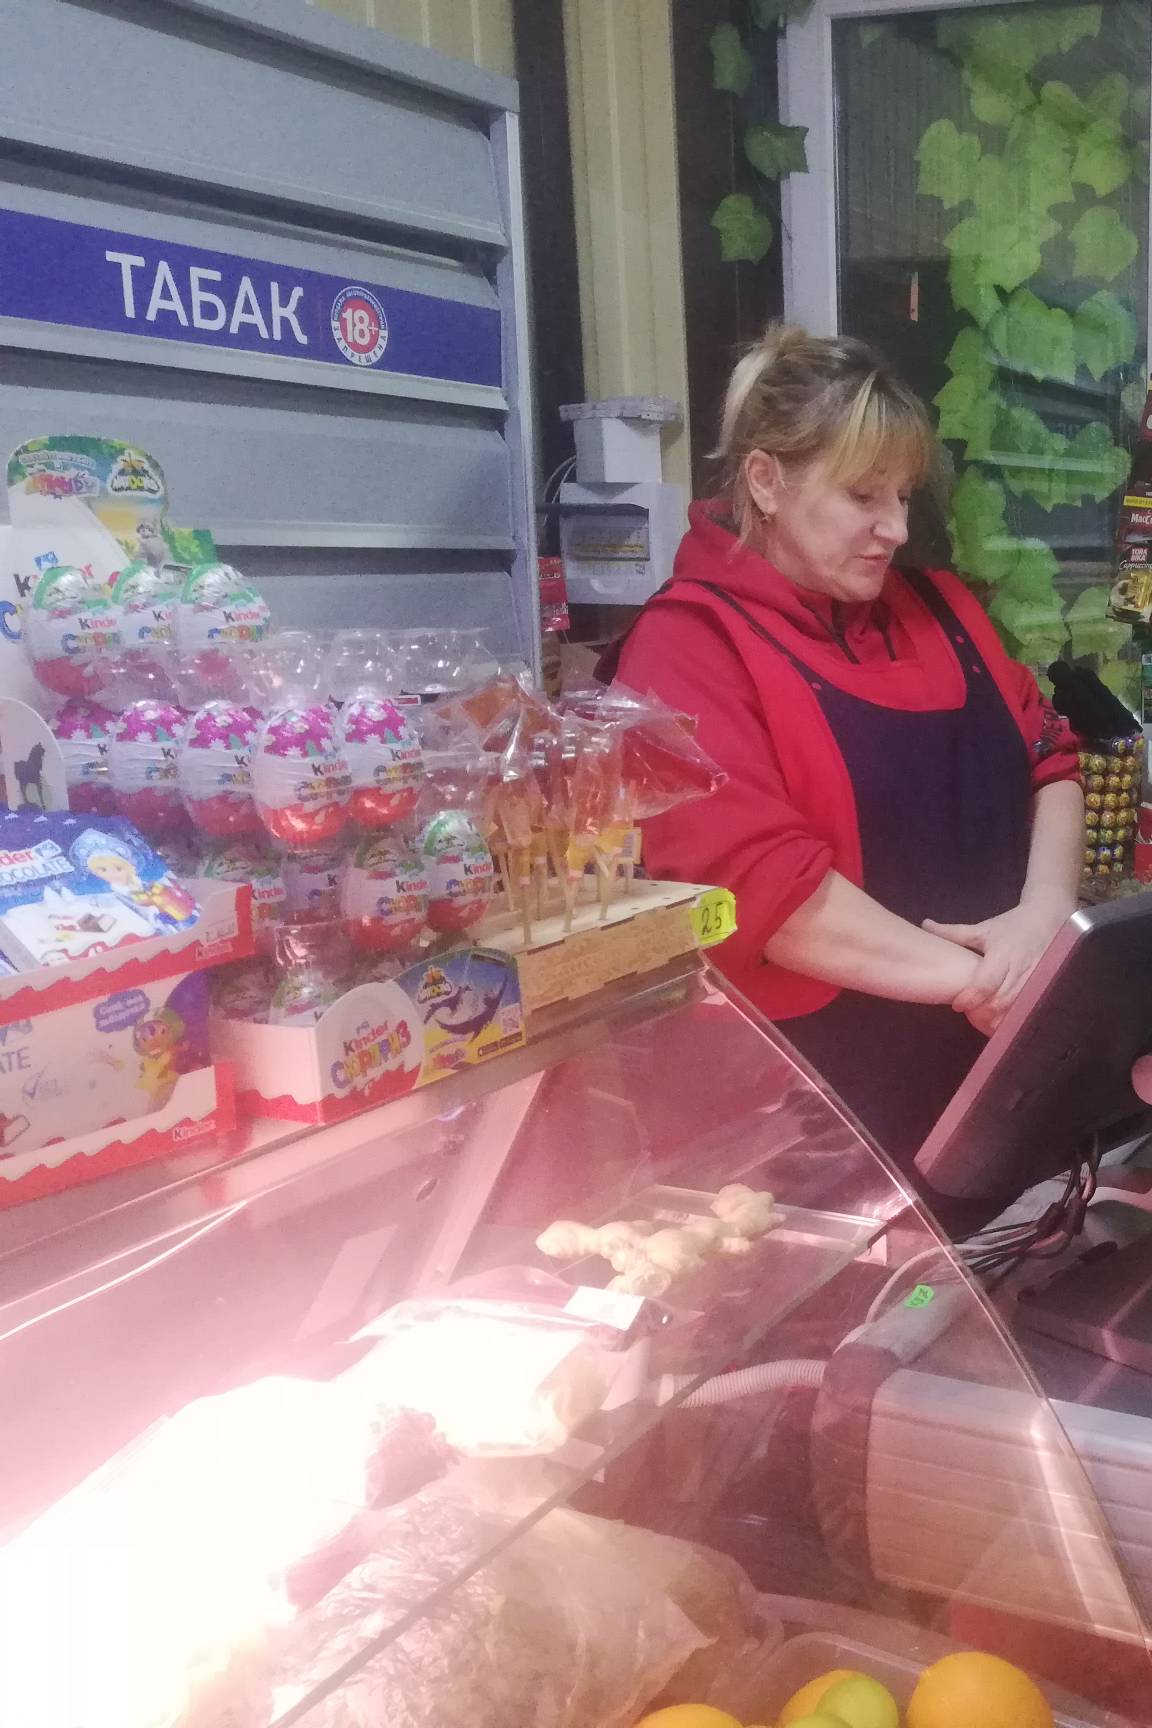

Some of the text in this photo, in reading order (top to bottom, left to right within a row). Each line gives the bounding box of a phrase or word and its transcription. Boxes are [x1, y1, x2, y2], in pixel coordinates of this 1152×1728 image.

[105, 250, 308, 345] ТАБАК
[701, 902, 723, 936] 25
[343, 1020, 388, 1056] Kinder
